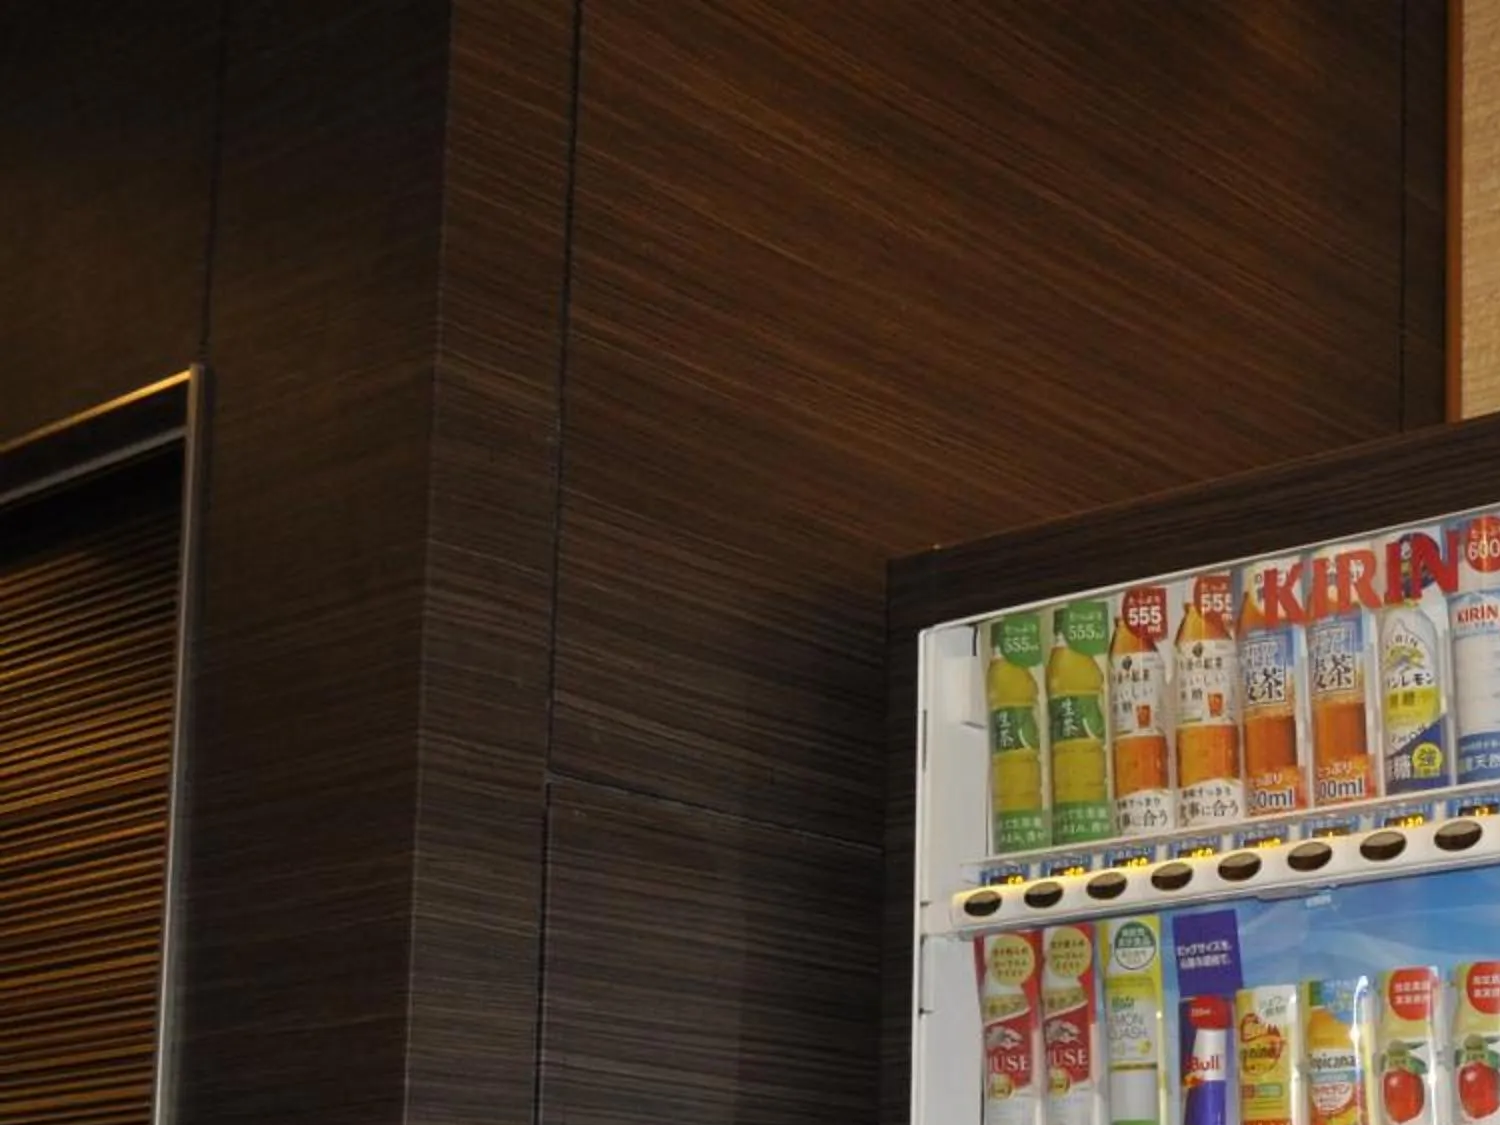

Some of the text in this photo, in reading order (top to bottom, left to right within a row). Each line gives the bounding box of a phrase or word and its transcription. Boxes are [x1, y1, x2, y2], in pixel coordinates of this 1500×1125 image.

[1262, 529, 1460, 628] KIRIN
[1128, 605, 1162, 627] 555
[1457, 605, 1498, 625] KIRIN
